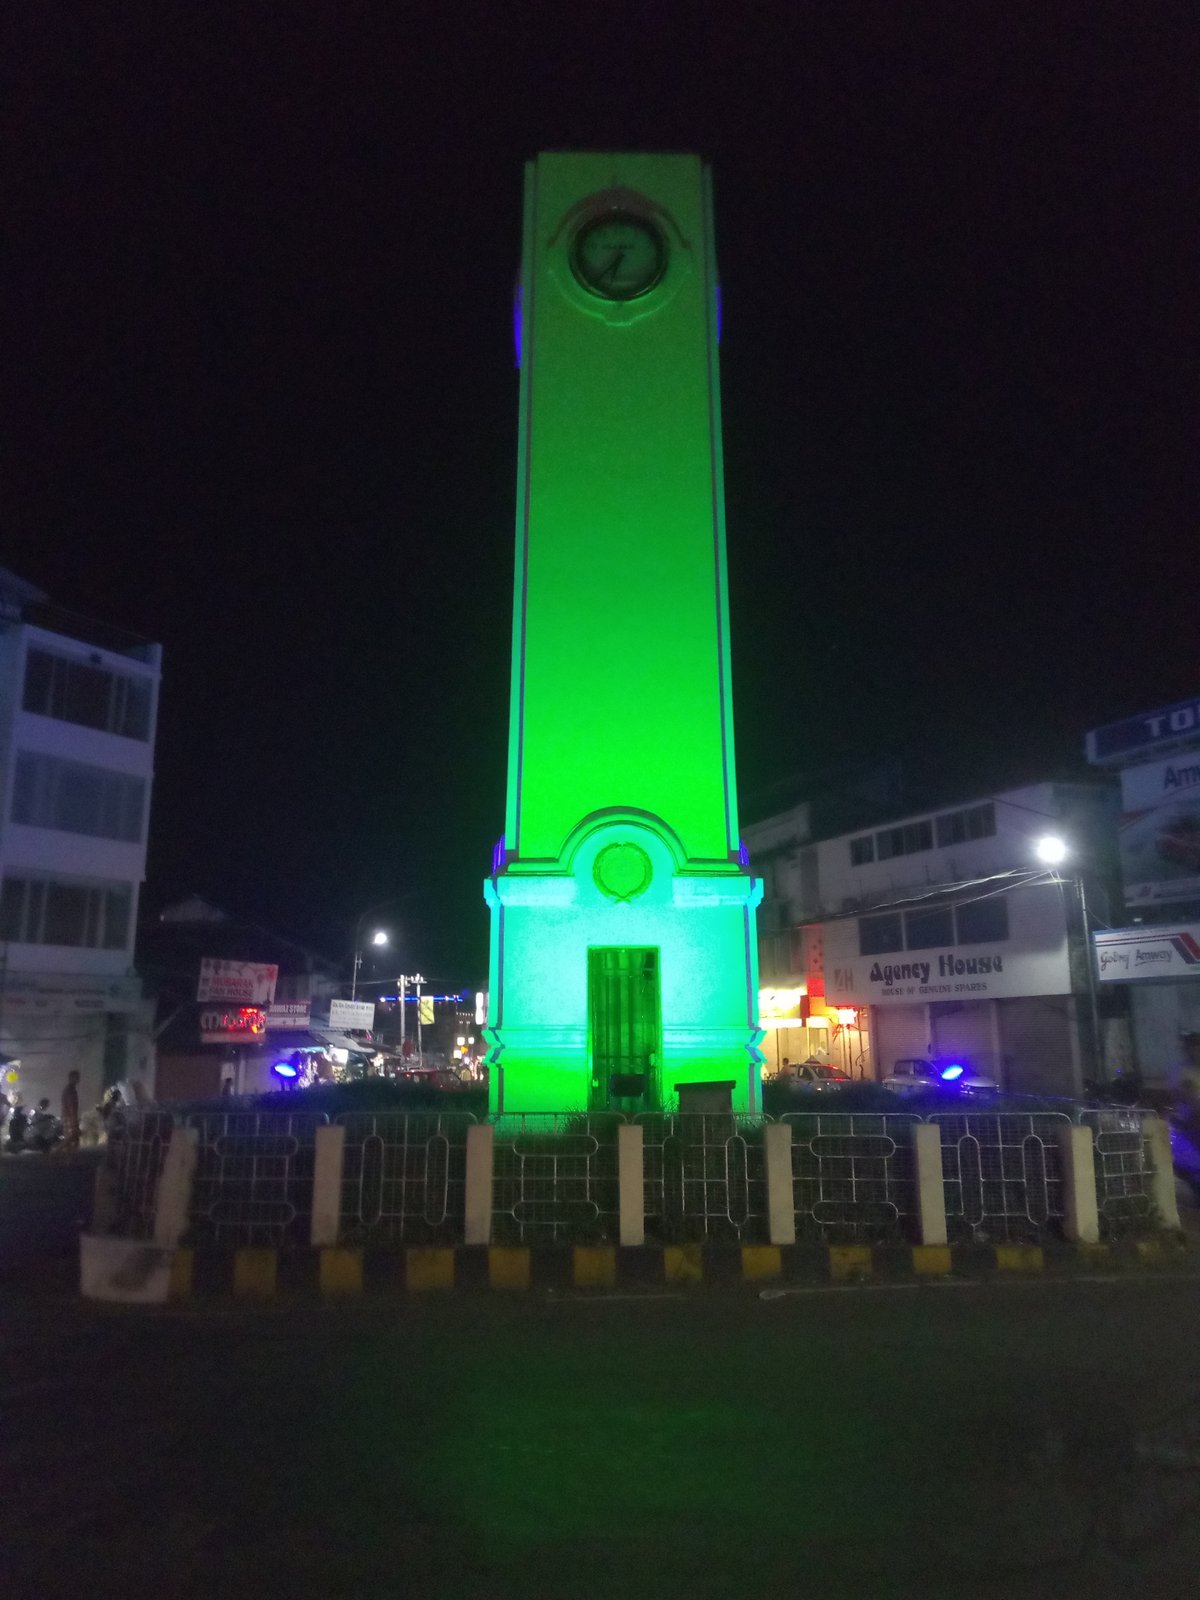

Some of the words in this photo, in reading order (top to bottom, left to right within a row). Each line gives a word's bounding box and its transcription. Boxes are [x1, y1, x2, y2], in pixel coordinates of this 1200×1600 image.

[1144, 703, 1200, 737] TO
[1163, 764, 1200, 789] Am
[870, 962, 930, 986] Agency
[938, 954, 1004, 977] House
[881, 987, 906, 996] HOUSE
[918, 984, 951, 995] GENUINE
[954, 982, 988, 992] SPARES
